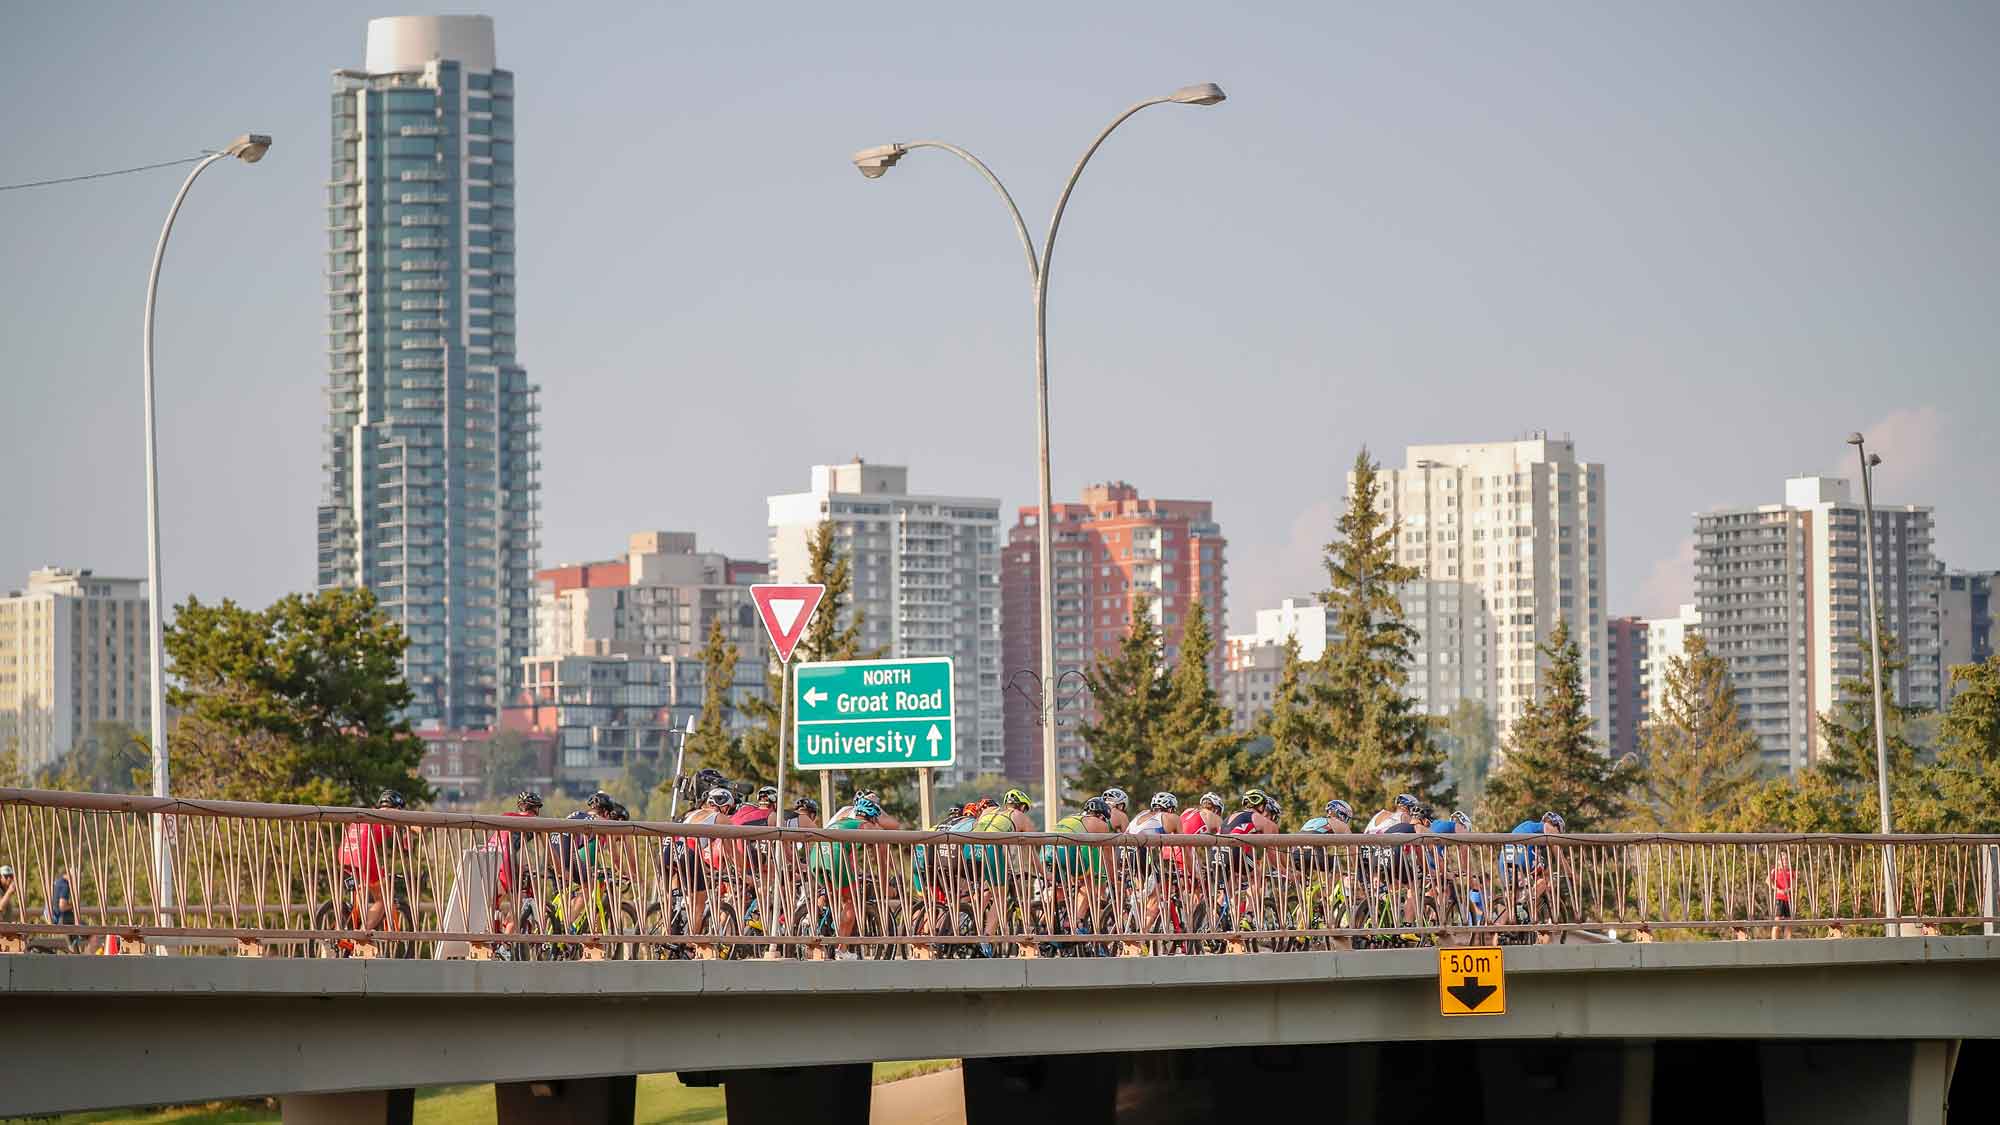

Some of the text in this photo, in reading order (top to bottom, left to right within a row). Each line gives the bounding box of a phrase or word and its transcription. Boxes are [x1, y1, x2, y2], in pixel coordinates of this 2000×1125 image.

[864, 669, 910, 685] NORTH
[837, 689, 942, 713] Groat Road
[807, 731, 916, 757] University
[1451, 955, 1489, 973] 5.0m
